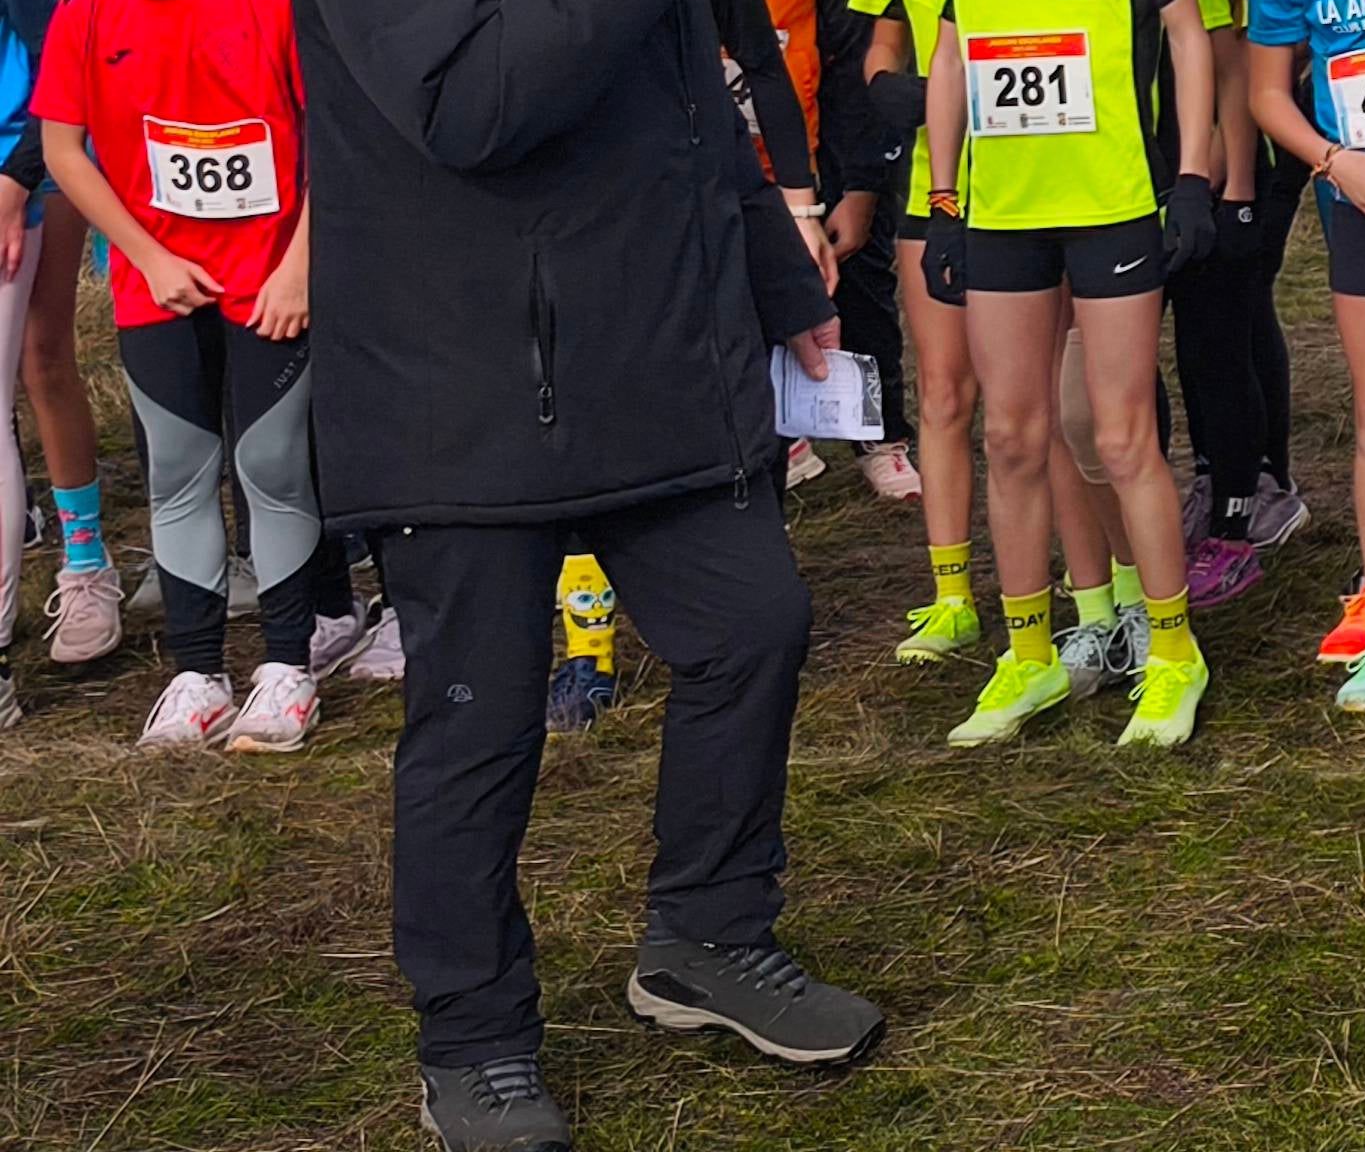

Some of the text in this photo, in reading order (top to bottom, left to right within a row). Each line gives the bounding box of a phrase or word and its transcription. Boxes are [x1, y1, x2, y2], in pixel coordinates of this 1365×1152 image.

[1332, 21, 1361, 34] CLUB
[994, 64, 1068, 108] 281
[169, 153, 253, 194] 368
